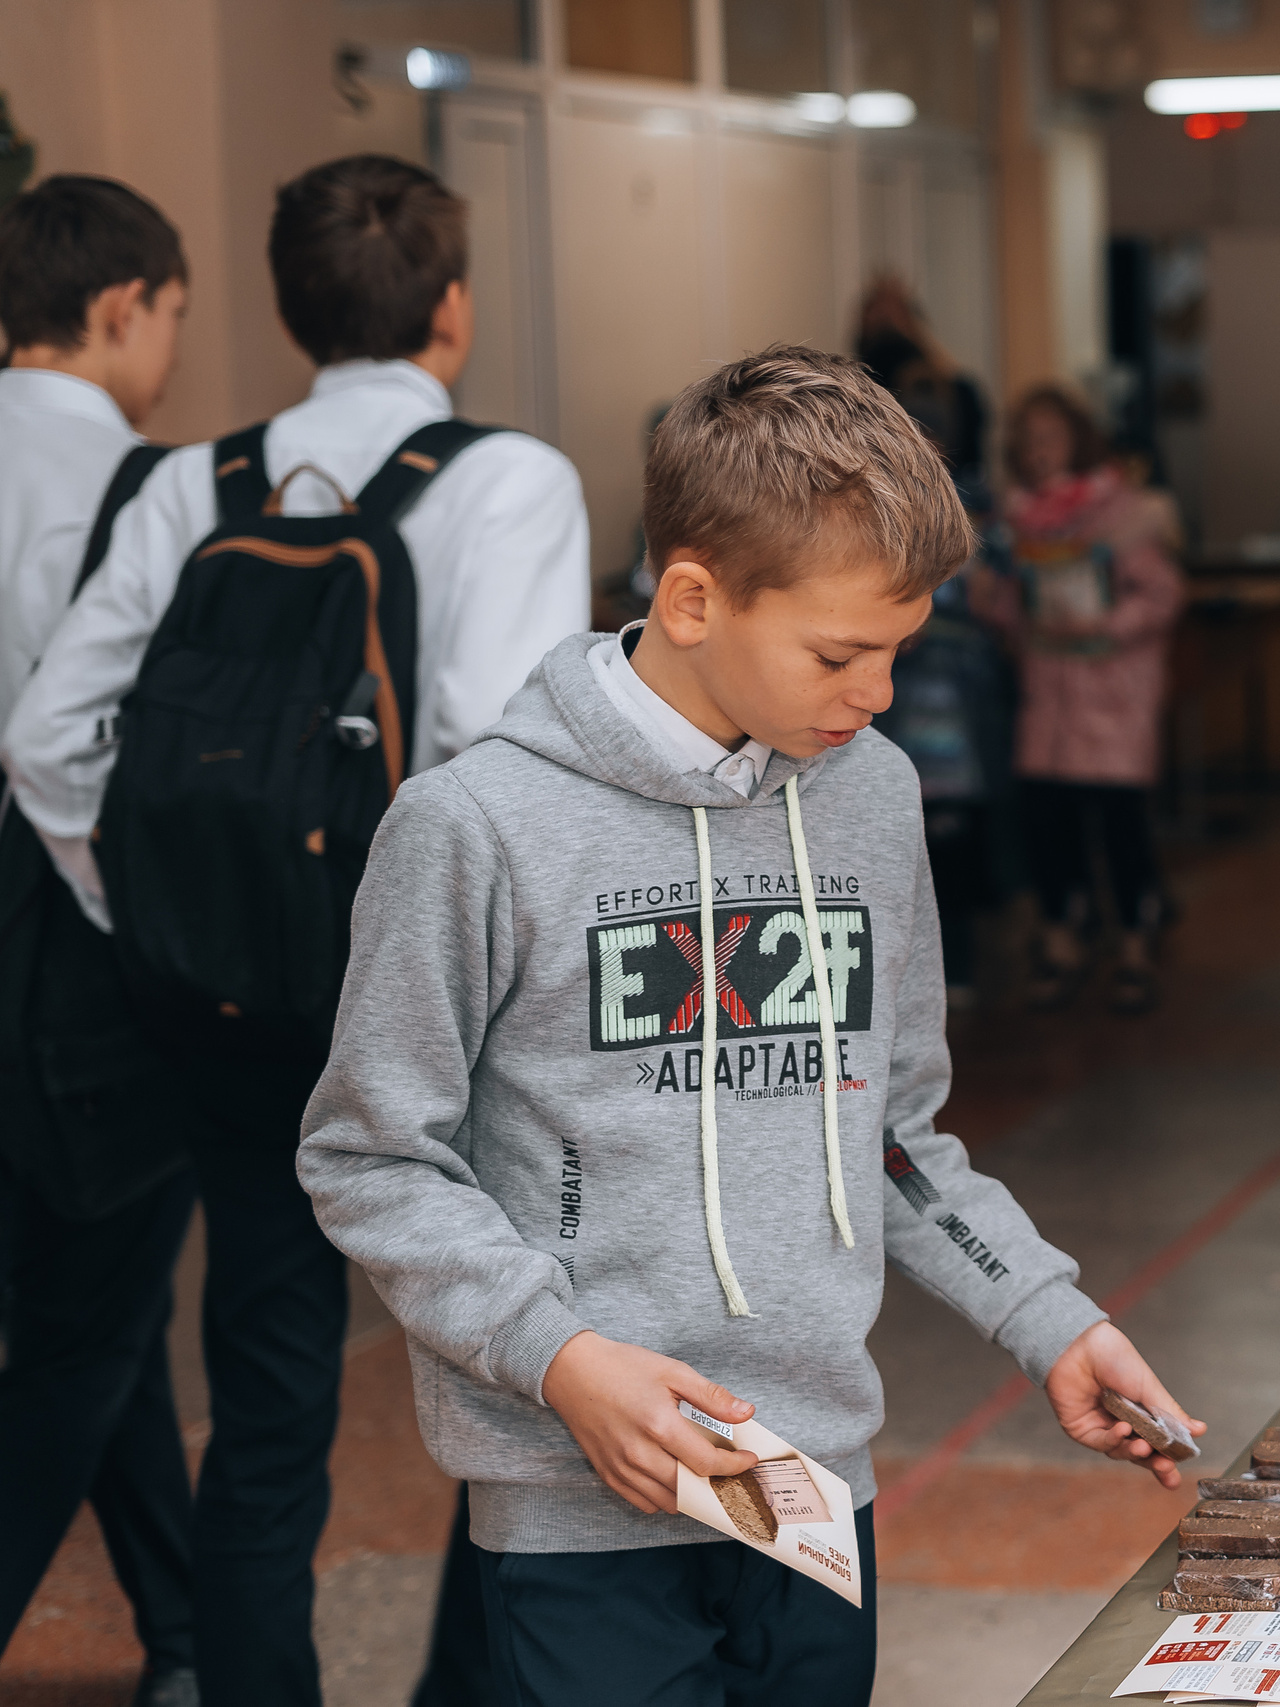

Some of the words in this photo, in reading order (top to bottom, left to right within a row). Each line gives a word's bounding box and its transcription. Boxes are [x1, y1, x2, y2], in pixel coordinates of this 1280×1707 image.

[597, 880, 699, 914] EFFORT
[714, 876, 731, 897] X
[743, 873, 860, 894] TRAIING
[654, 1038, 853, 1094] ADAPTABE
[735, 1085, 804, 1102] TECHNOLOGICAL
[559, 1135, 582, 1240] COMBATANT
[797, 1540, 852, 1582] БЛОКАДНЫЙ
[828, 1546, 851, 1569] ХЛЕБ
